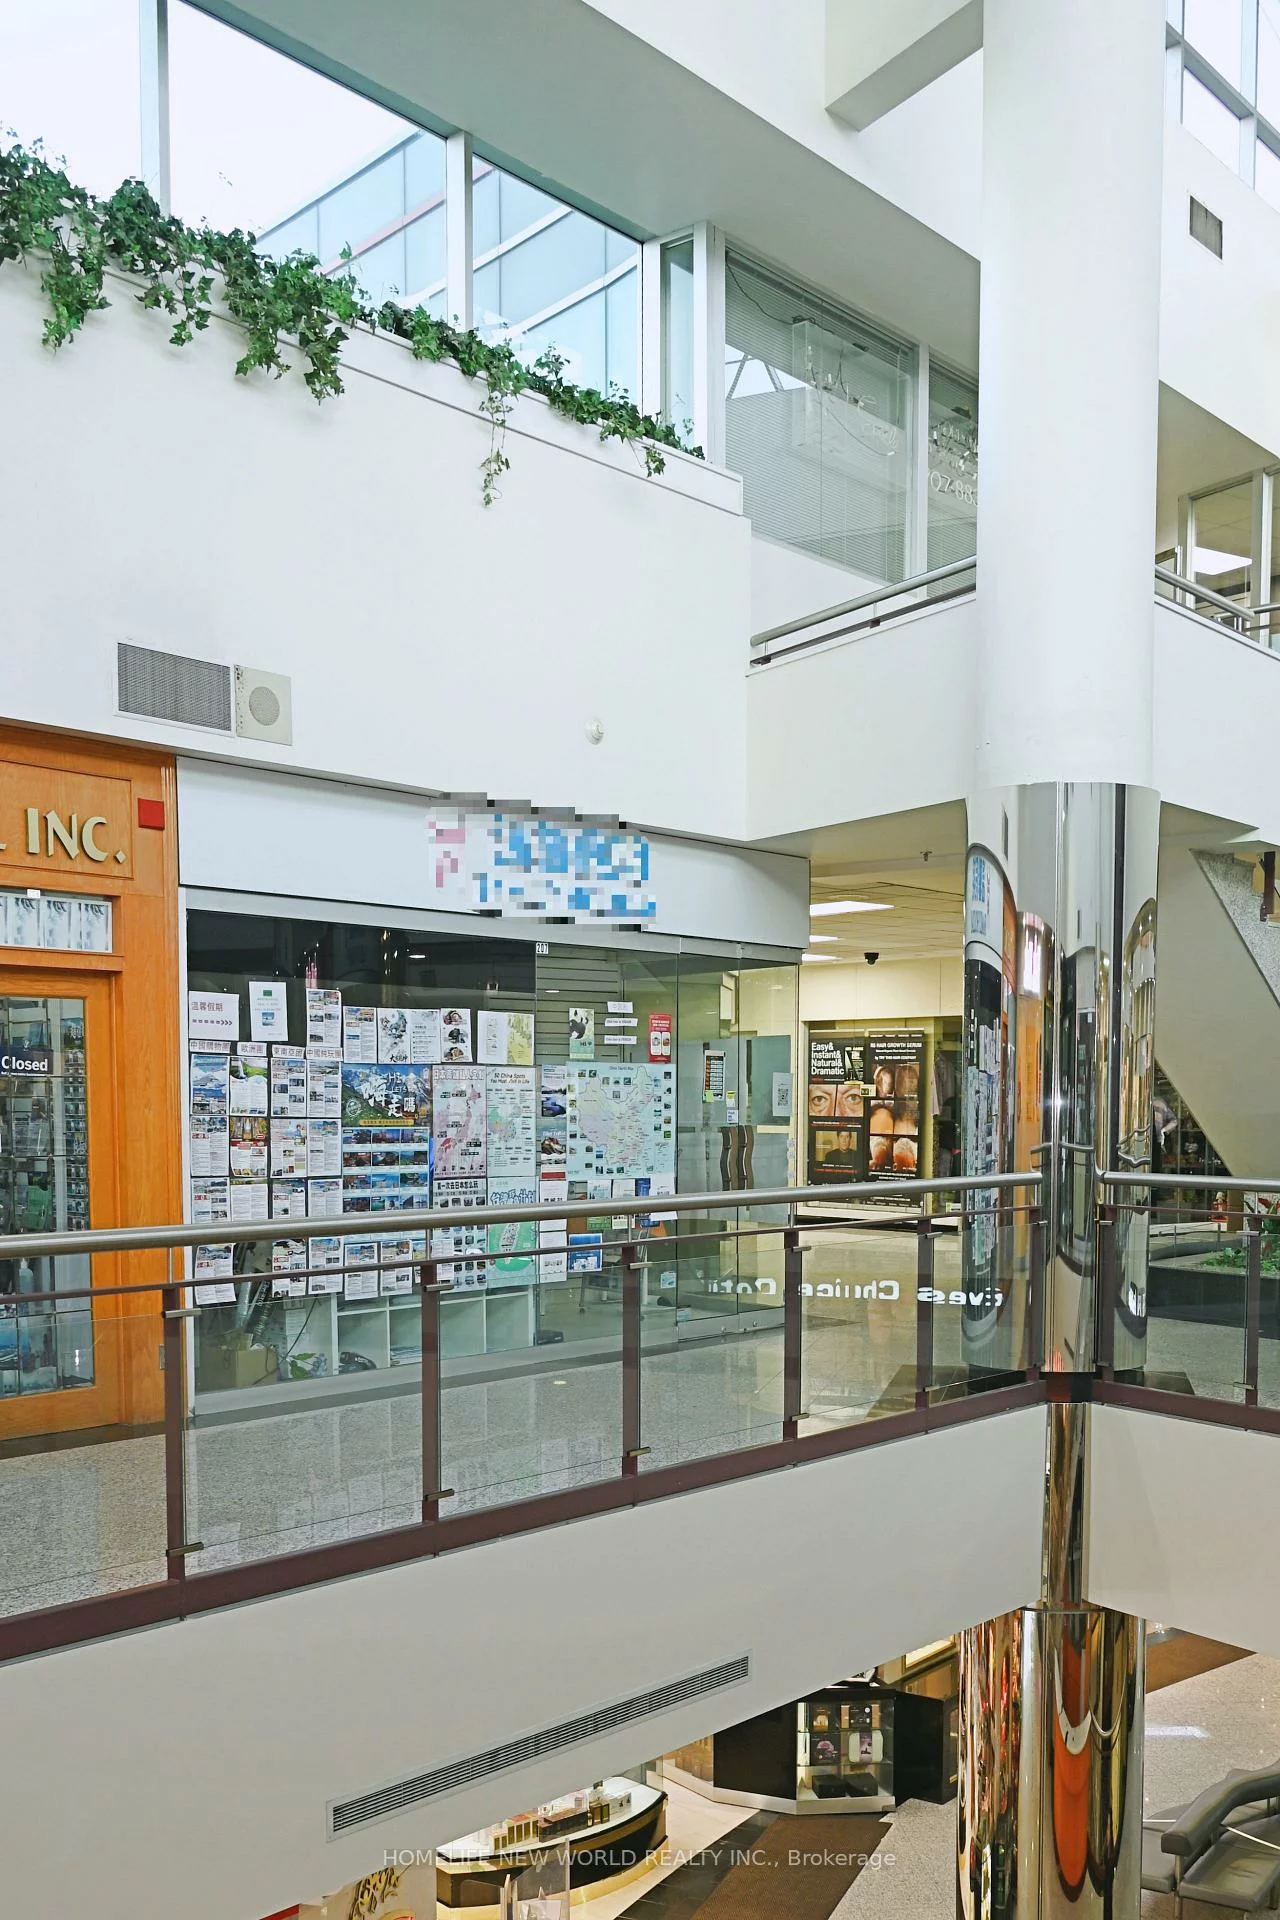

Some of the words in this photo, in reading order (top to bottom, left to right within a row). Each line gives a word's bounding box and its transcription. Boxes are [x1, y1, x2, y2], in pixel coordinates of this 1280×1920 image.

[25, 807, 126, 864] INC.
[536, 943, 548, 954] 207
[811, 1042, 834, 1053] Easy&
[811, 1051, 841, 1059] Instant&
[1, 1055, 48, 1072] Closed
[811, 1059, 843, 1067] Natural&
[811, 1067, 845, 1075] Dramatic
